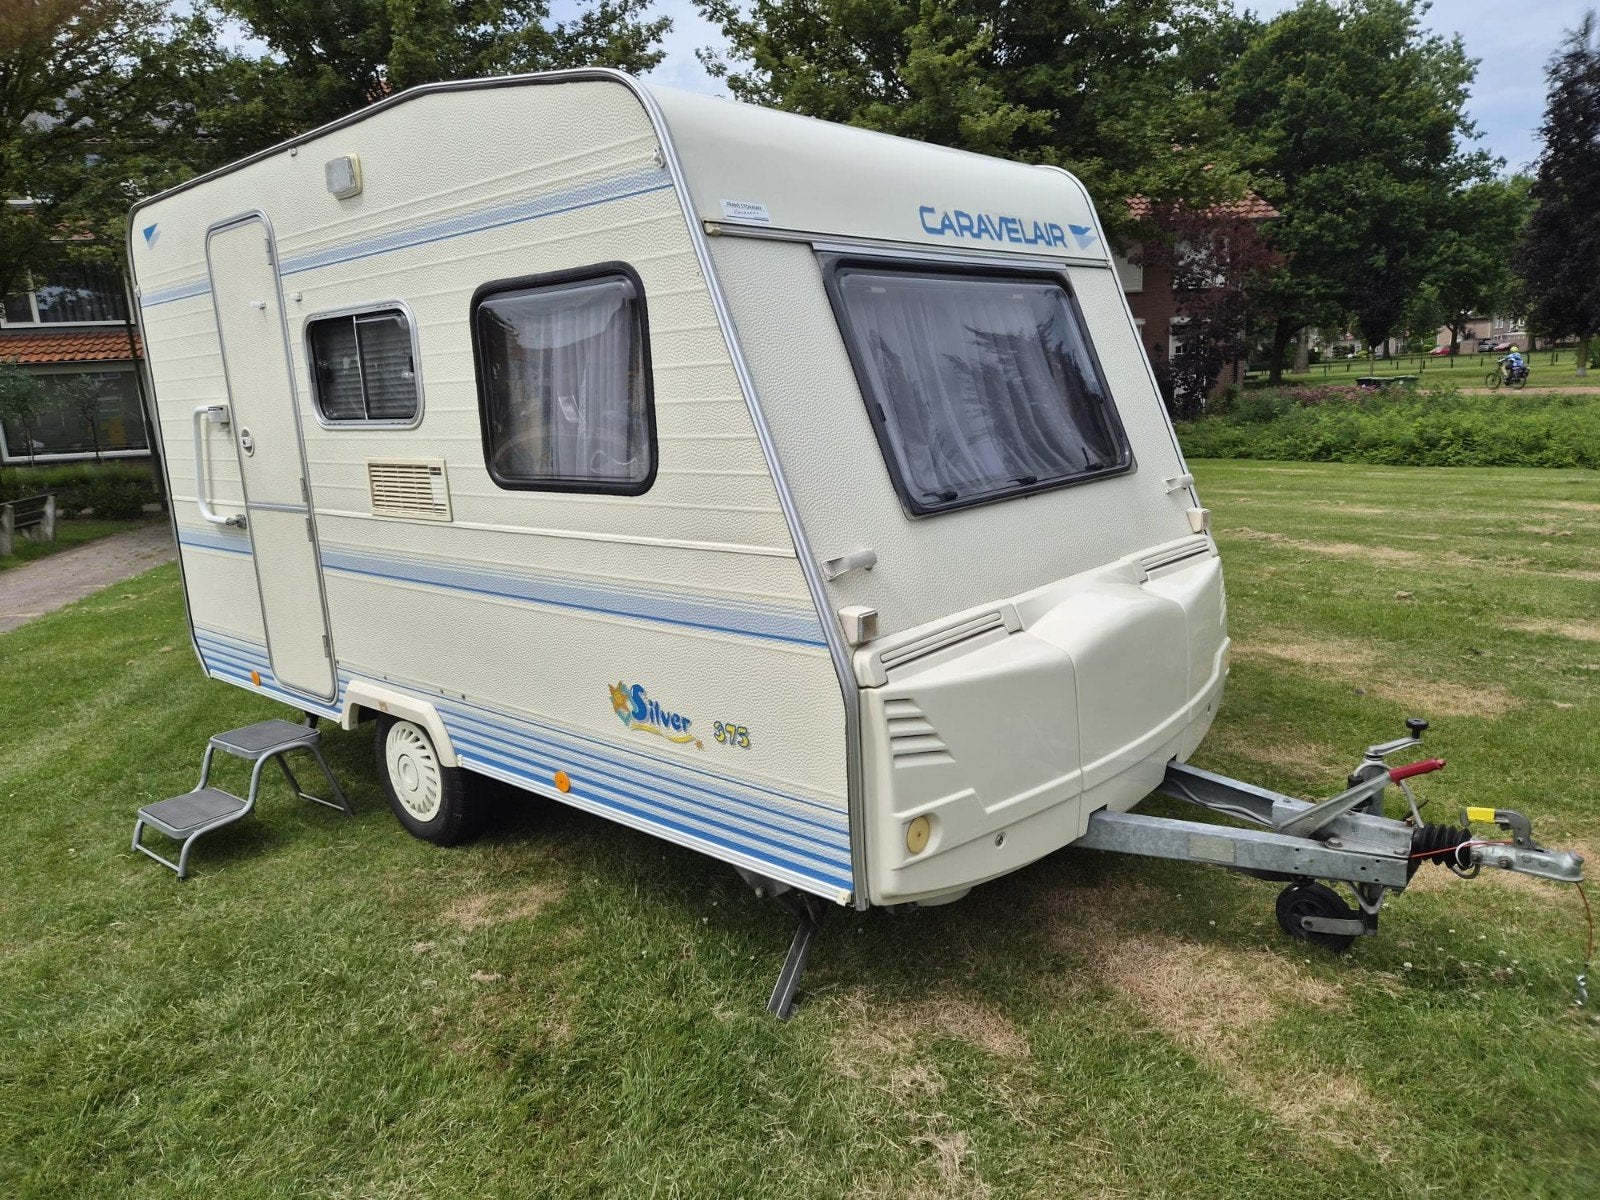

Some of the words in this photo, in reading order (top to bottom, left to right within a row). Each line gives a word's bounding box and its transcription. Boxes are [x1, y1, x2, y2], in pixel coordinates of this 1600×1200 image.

[919, 205, 1068, 248] CARAVELAIR
[630, 684, 692, 733] Silver
[713, 721, 750, 748] 375
